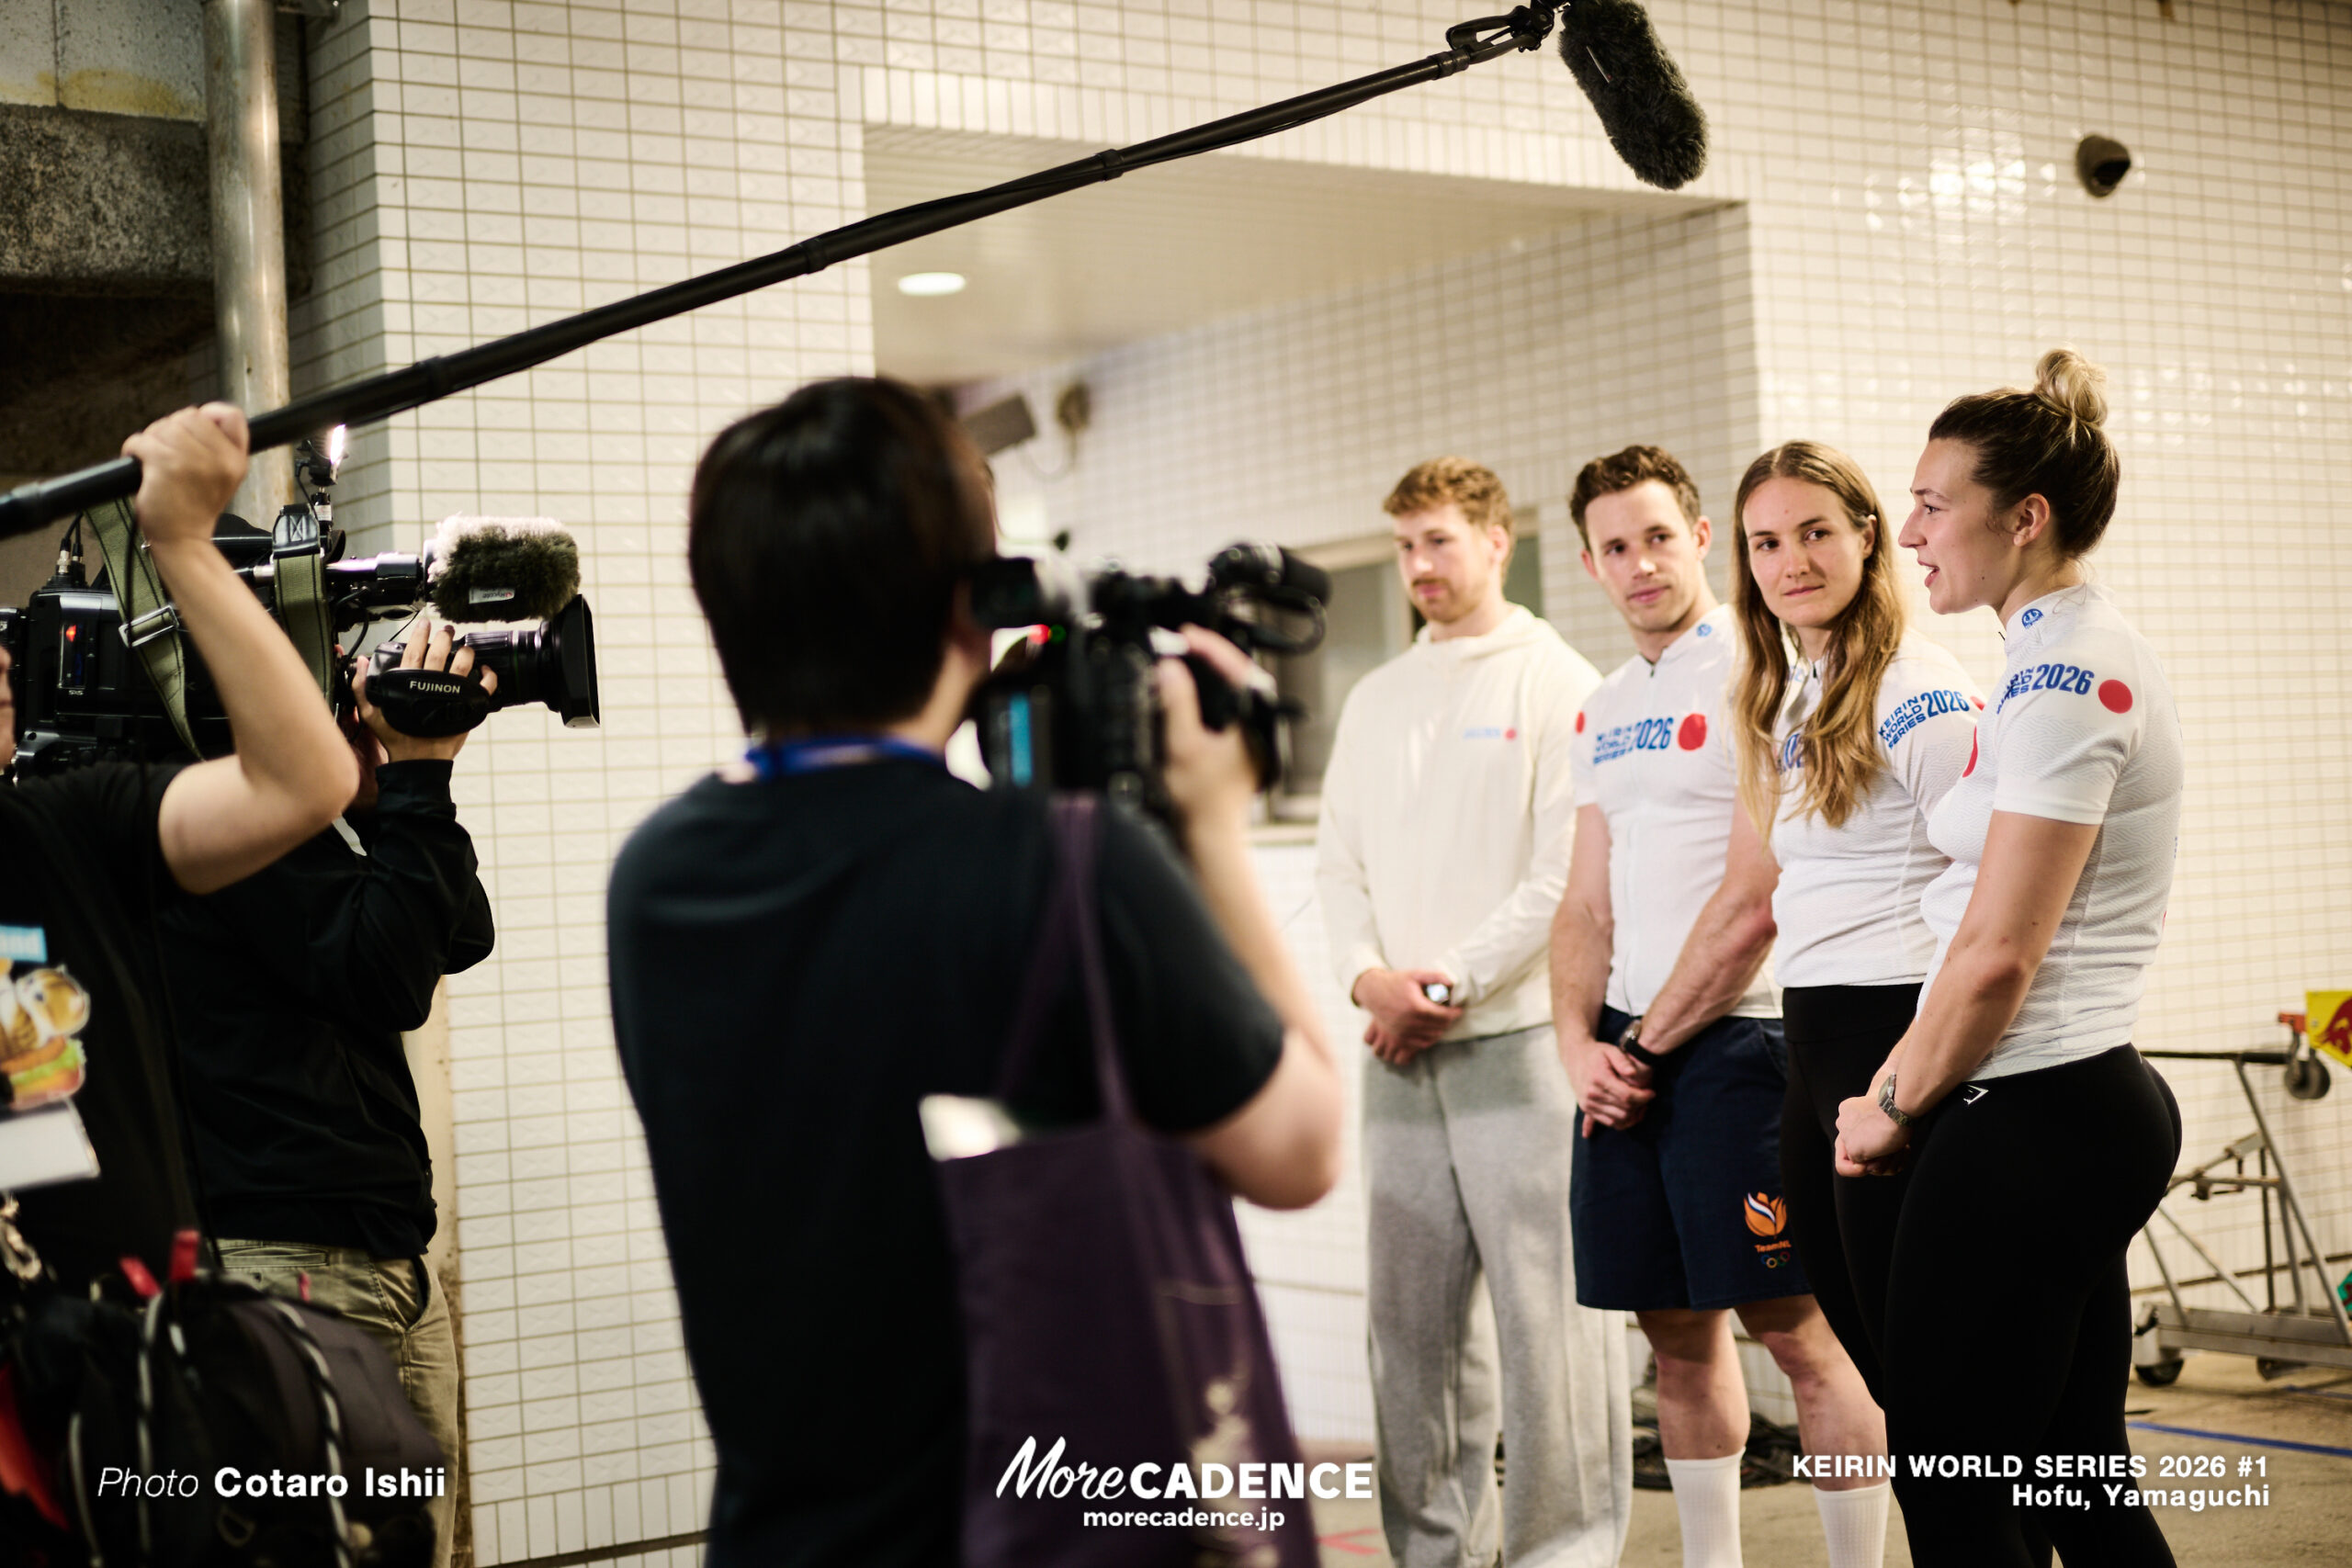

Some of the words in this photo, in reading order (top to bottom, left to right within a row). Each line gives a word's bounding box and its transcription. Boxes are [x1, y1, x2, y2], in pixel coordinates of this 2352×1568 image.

[409, 681, 461, 694] FUJINON
[2031, 663, 2095, 695] 2026
[1878, 695, 1919, 737] KEIRIN
[1920, 690, 1970, 718] 2026
[1883, 705, 1922, 741] WORLD
[1888, 713, 1927, 750] SERIES
